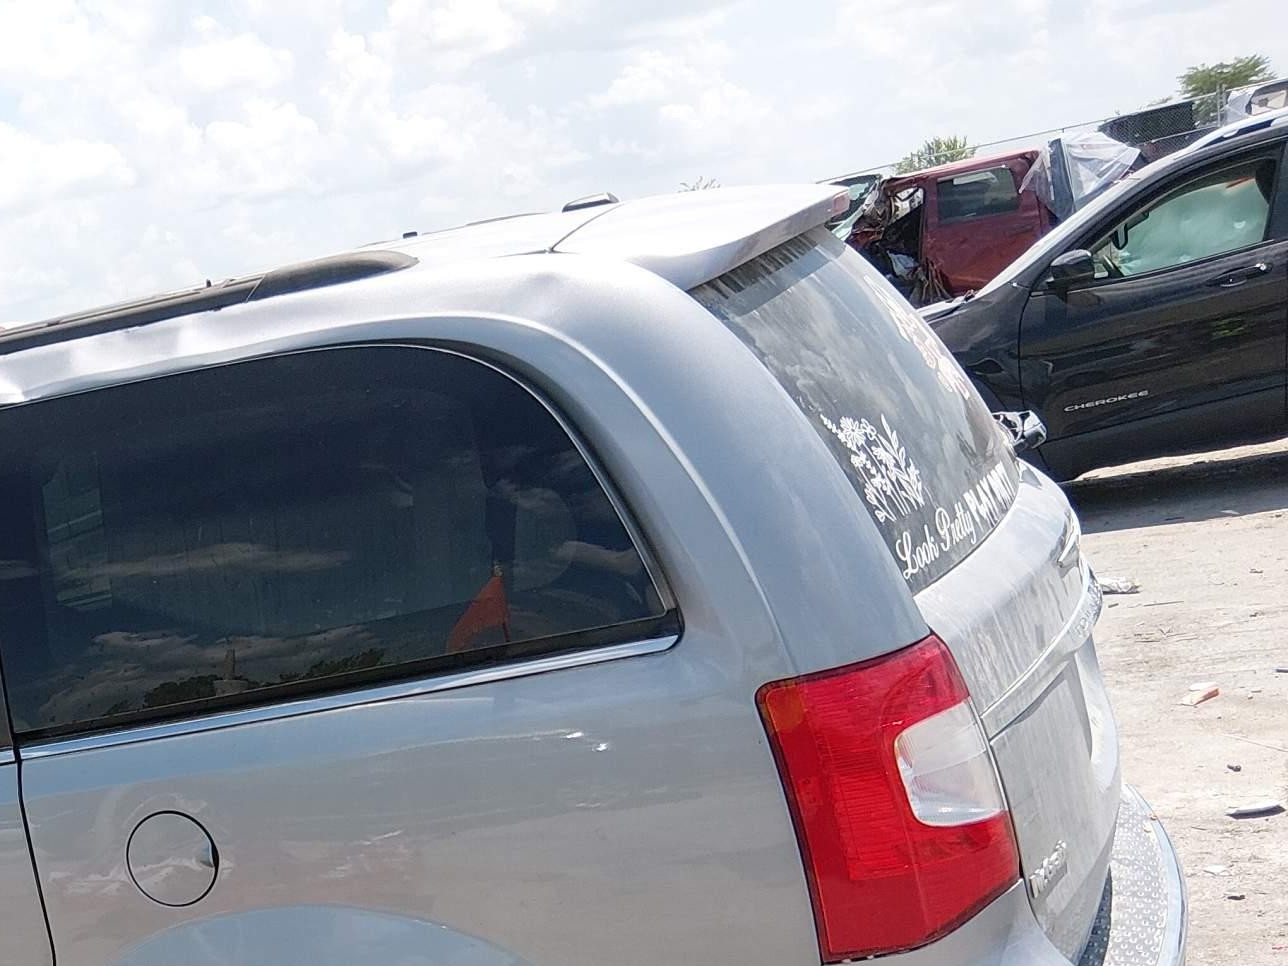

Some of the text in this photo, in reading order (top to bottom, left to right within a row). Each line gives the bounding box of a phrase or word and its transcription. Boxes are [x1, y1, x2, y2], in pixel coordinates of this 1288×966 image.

[1063, 389, 1149, 412] CHEROKEE
[896, 524, 940, 579] Look
[935, 500, 977, 551] Pretty
